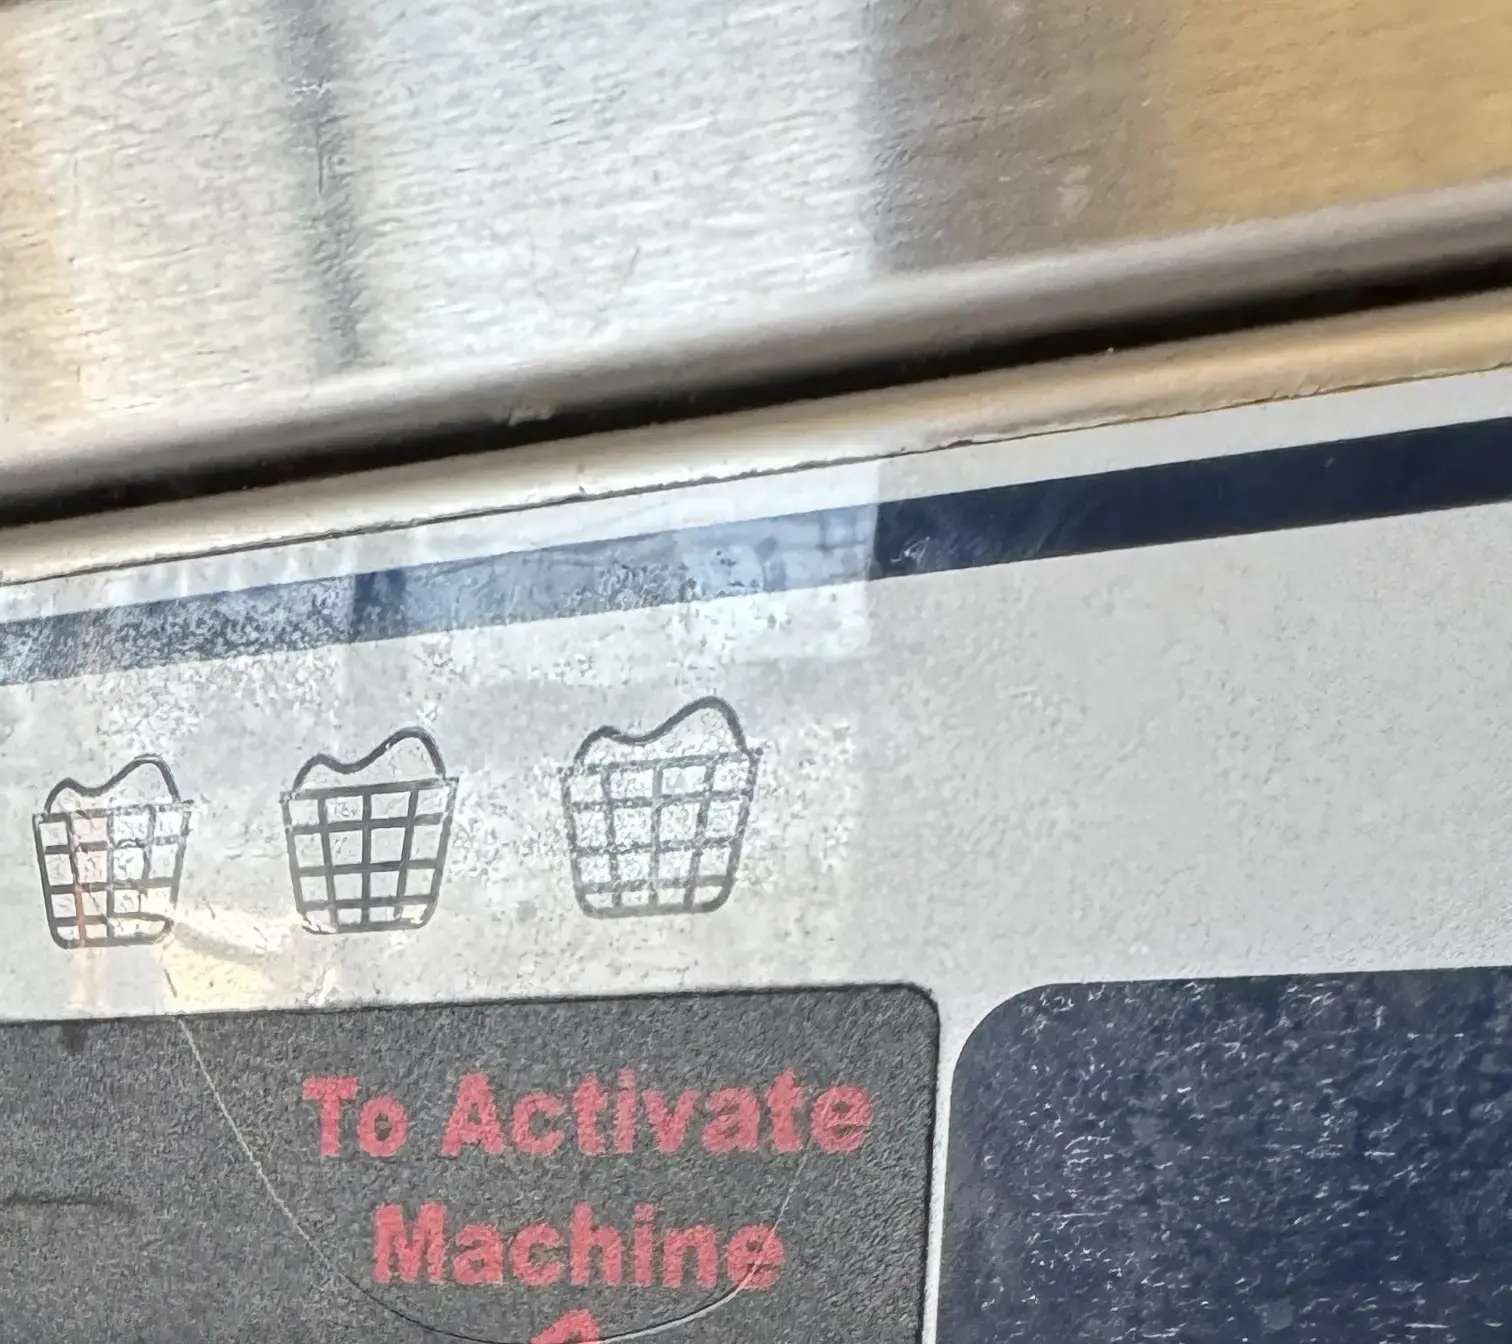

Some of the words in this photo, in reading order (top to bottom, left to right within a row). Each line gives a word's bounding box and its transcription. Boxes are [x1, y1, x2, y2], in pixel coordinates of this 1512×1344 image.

[301, 1074, 408, 1160] To
[441, 1066, 875, 1156] Activate
[373, 1202, 786, 1290] Machine
